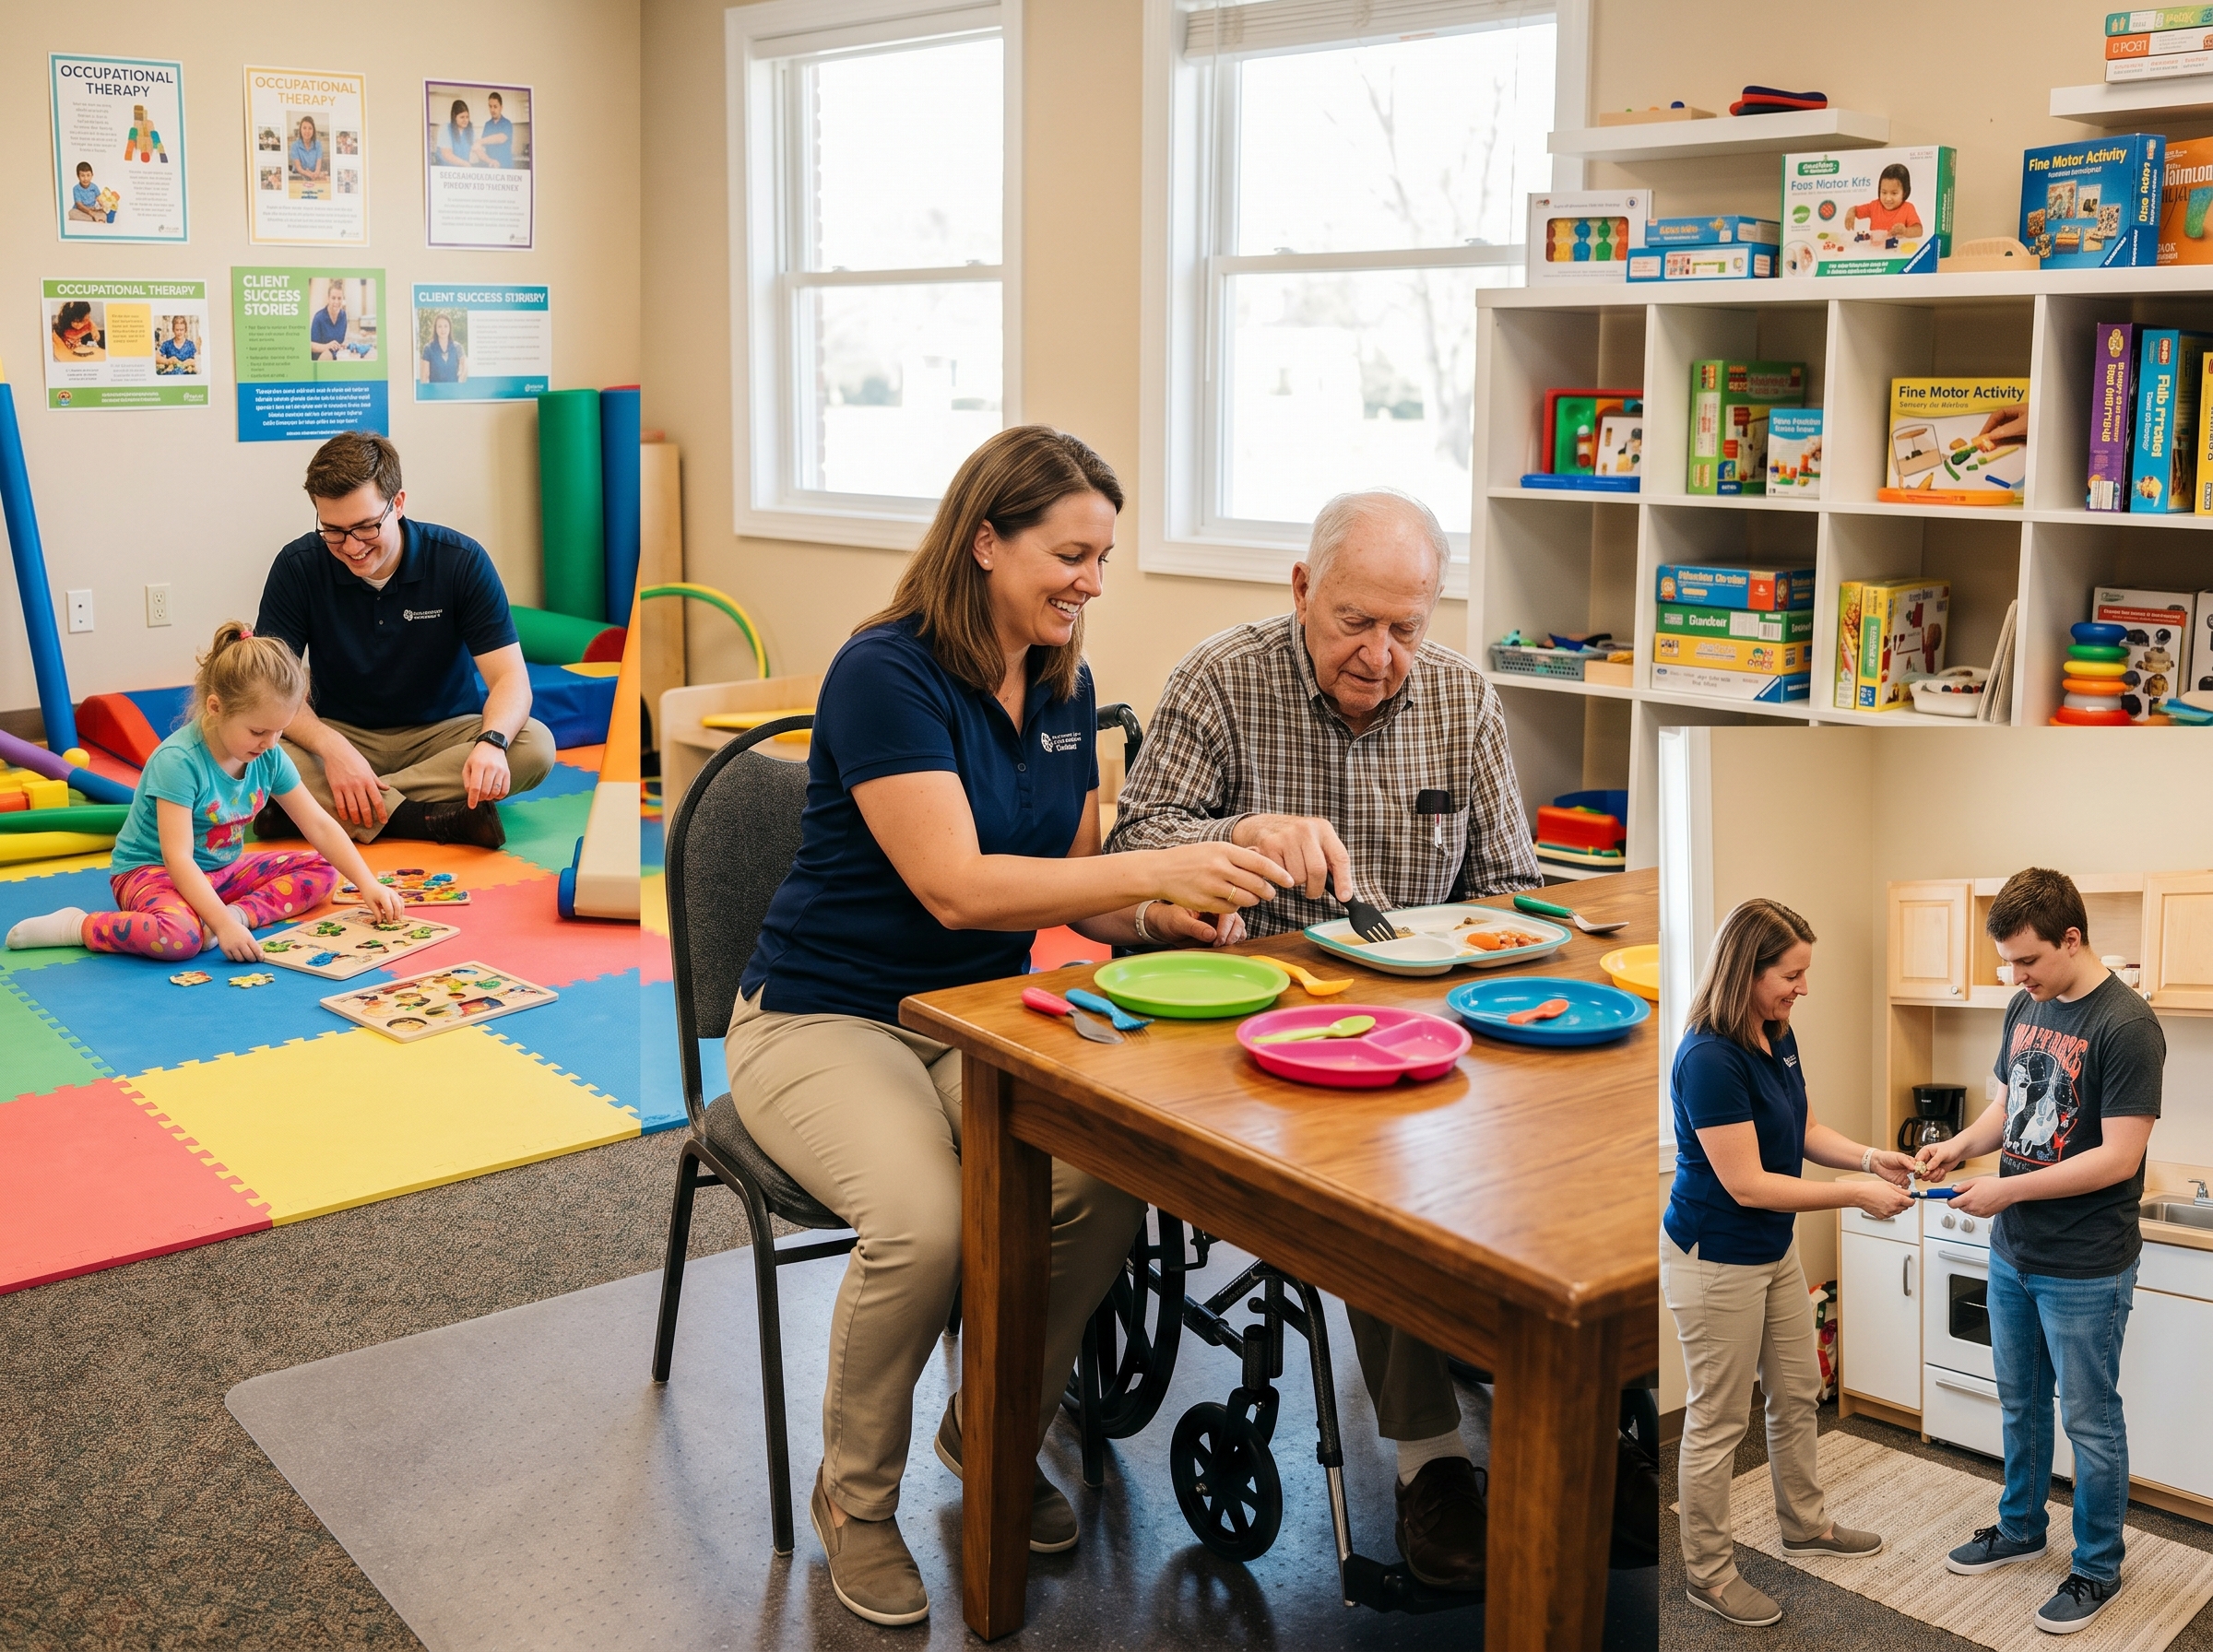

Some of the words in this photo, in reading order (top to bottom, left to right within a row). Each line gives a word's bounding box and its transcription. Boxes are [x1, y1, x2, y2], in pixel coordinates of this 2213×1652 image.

[61, 65, 174, 84] OCCUPATIONAL
[85, 82, 151, 98] THERAPY
[254, 77, 357, 94] OCCUPATIONAL
[278, 92, 337, 107] THERAPY
[2029, 158, 2051, 171] Fine
[2052, 154, 2085, 169] Motor
[2086, 148, 2127, 164] Activity
[243, 275, 290, 288] CLIENT
[57, 284, 147, 296] OCCUPATIONAL
[148, 285, 196, 296] THERAPY
[243, 289, 302, 302] SUCCESS
[419, 291, 456, 302] CLIENT
[456, 292, 503, 302] SUCCESS
[244, 303, 299, 316] STORIES
[1899, 386, 1926, 398] Fine
[1930, 386, 1970, 398] Motor
[1973, 385, 2025, 402] Activity
